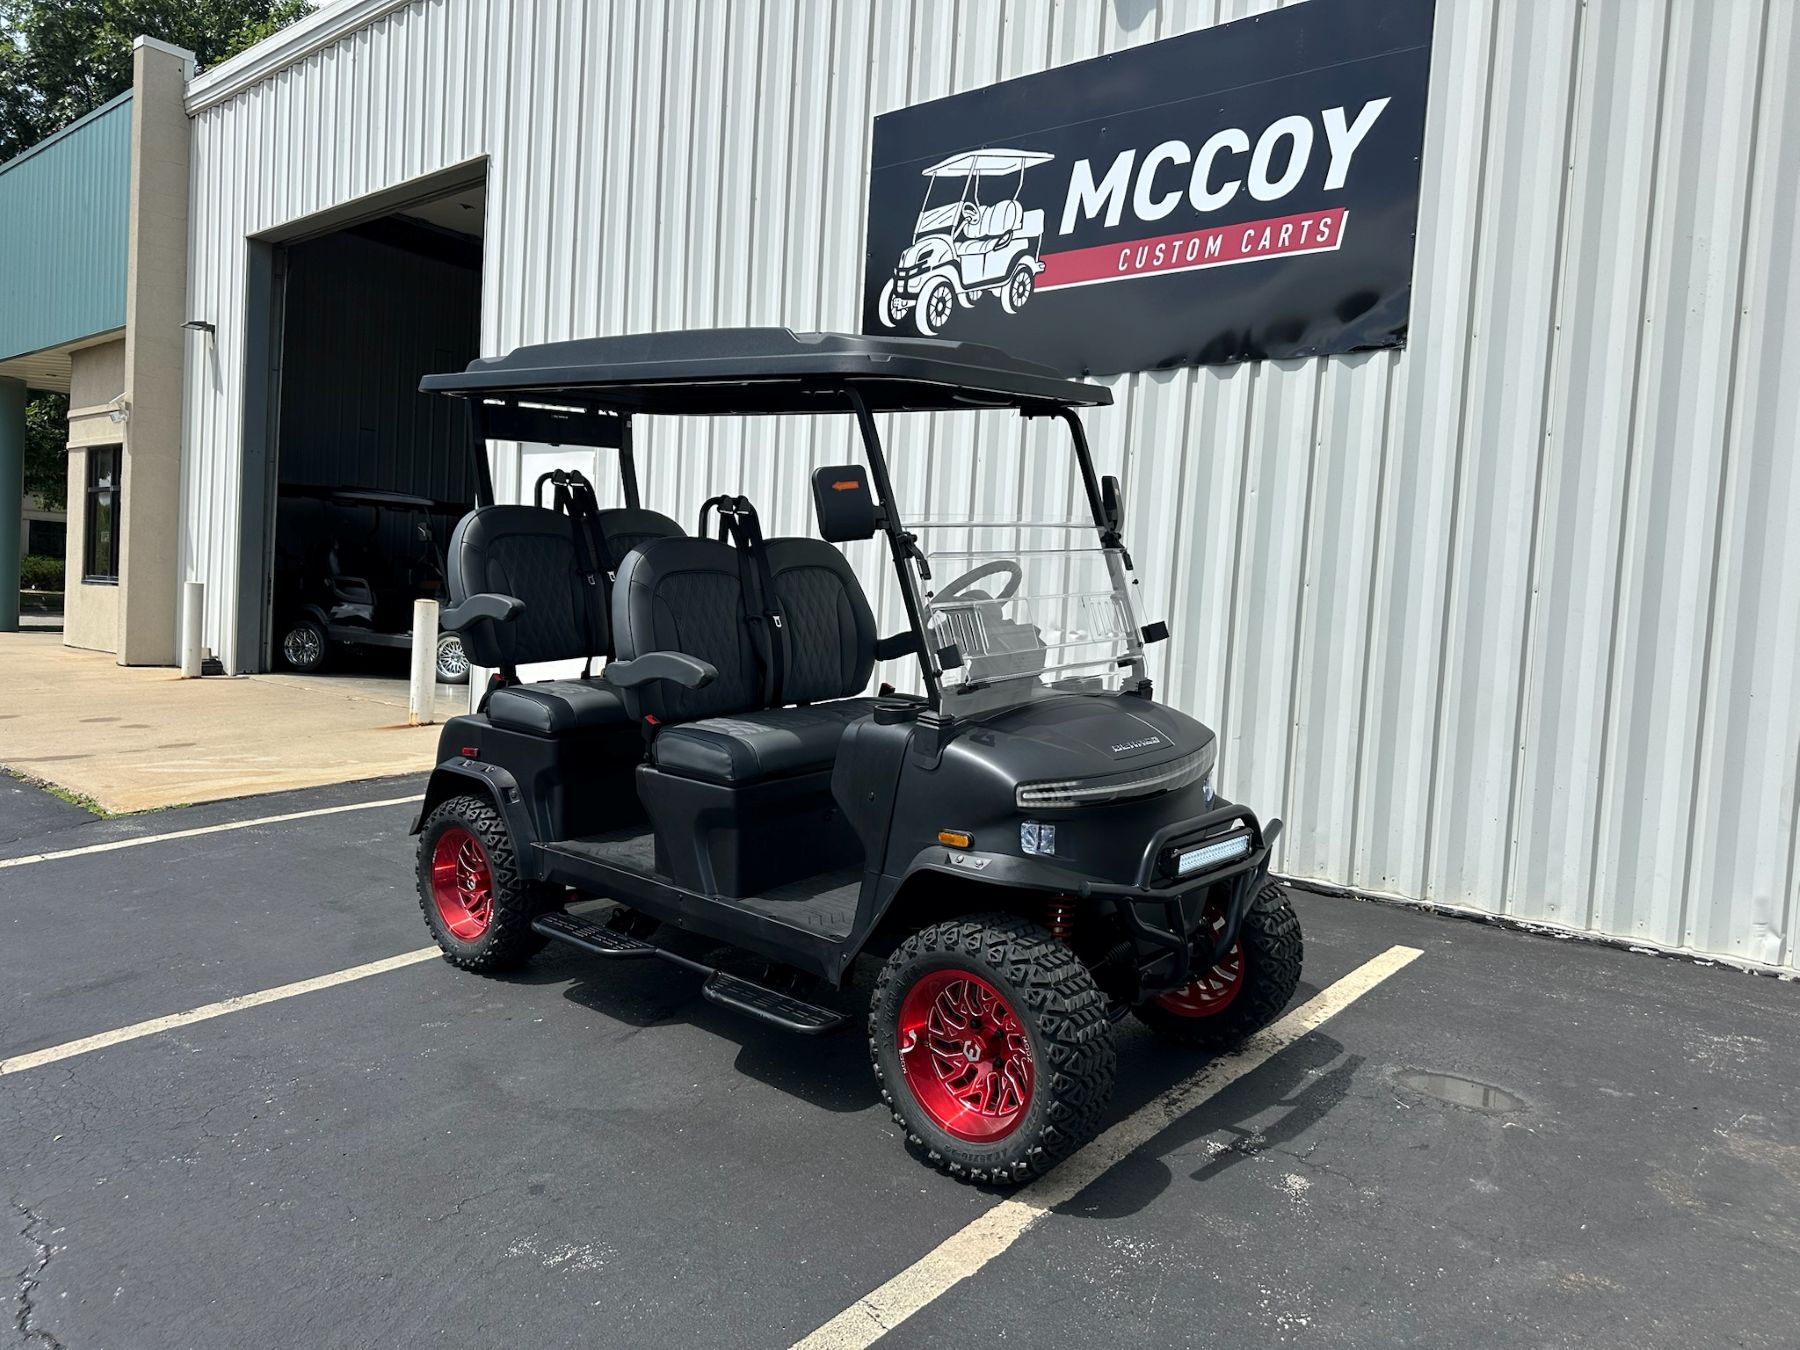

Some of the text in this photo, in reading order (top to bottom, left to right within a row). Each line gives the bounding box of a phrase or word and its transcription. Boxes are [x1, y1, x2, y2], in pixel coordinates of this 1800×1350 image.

[1058, 96, 1392, 235] MCCOY
[1118, 217, 1332, 271] CUSTOM CARTS
